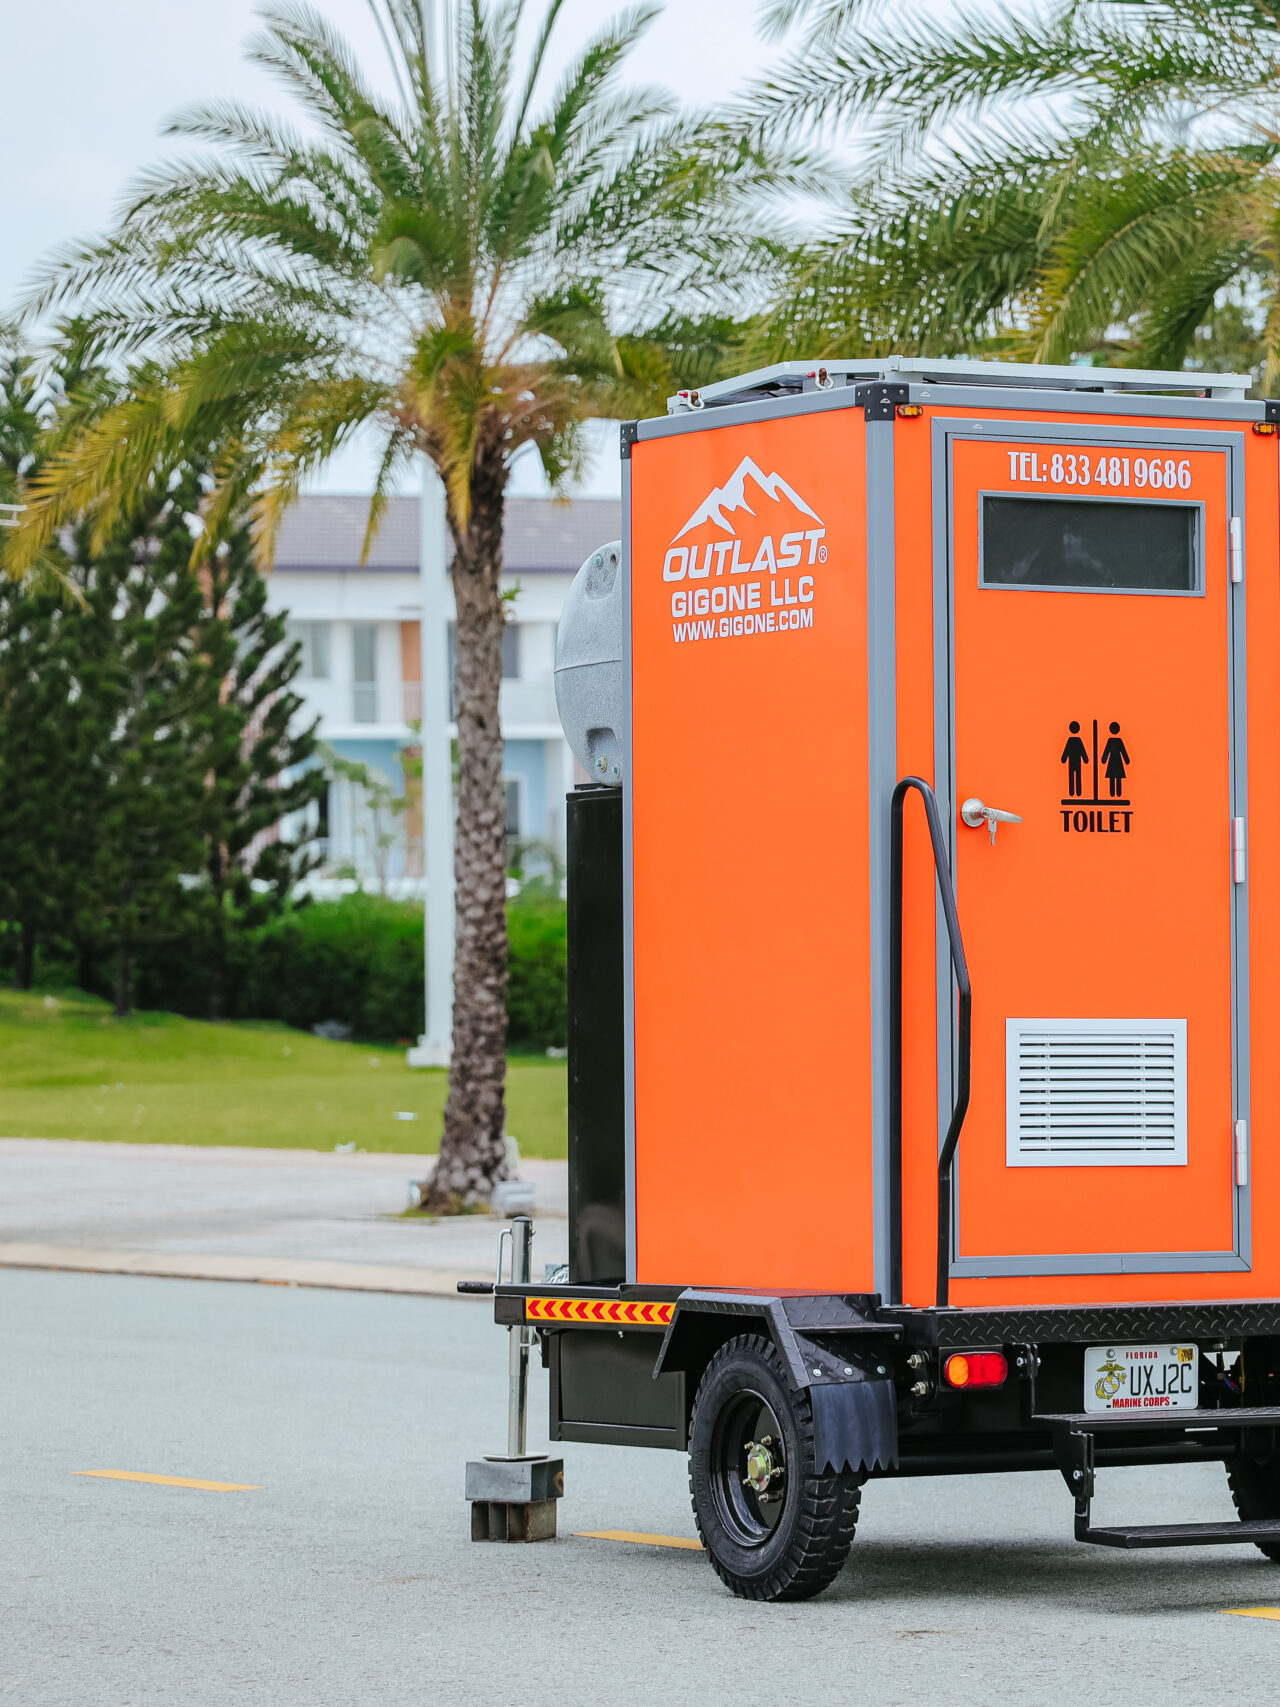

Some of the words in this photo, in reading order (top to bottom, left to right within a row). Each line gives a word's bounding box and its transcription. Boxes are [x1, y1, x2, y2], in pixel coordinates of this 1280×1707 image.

[1050, 453, 1091, 486] 833
[1094, 457, 1130, 487] 481
[1134, 458, 1192, 490] 9686
[671, 582, 761, 618] GIGONE
[770, 575, 814, 607] LLC
[672, 607, 814, 643] WWW.GIGONE.COM
[1060, 810, 1134, 833] TOILET
[1125, 1351, 1158, 1360] FLORIDA
[1130, 1363, 1192, 1396] UXJ2C
[1112, 1397, 1142, 1408] MARINE
[1143, 1396, 1170, 1407] CORPS
